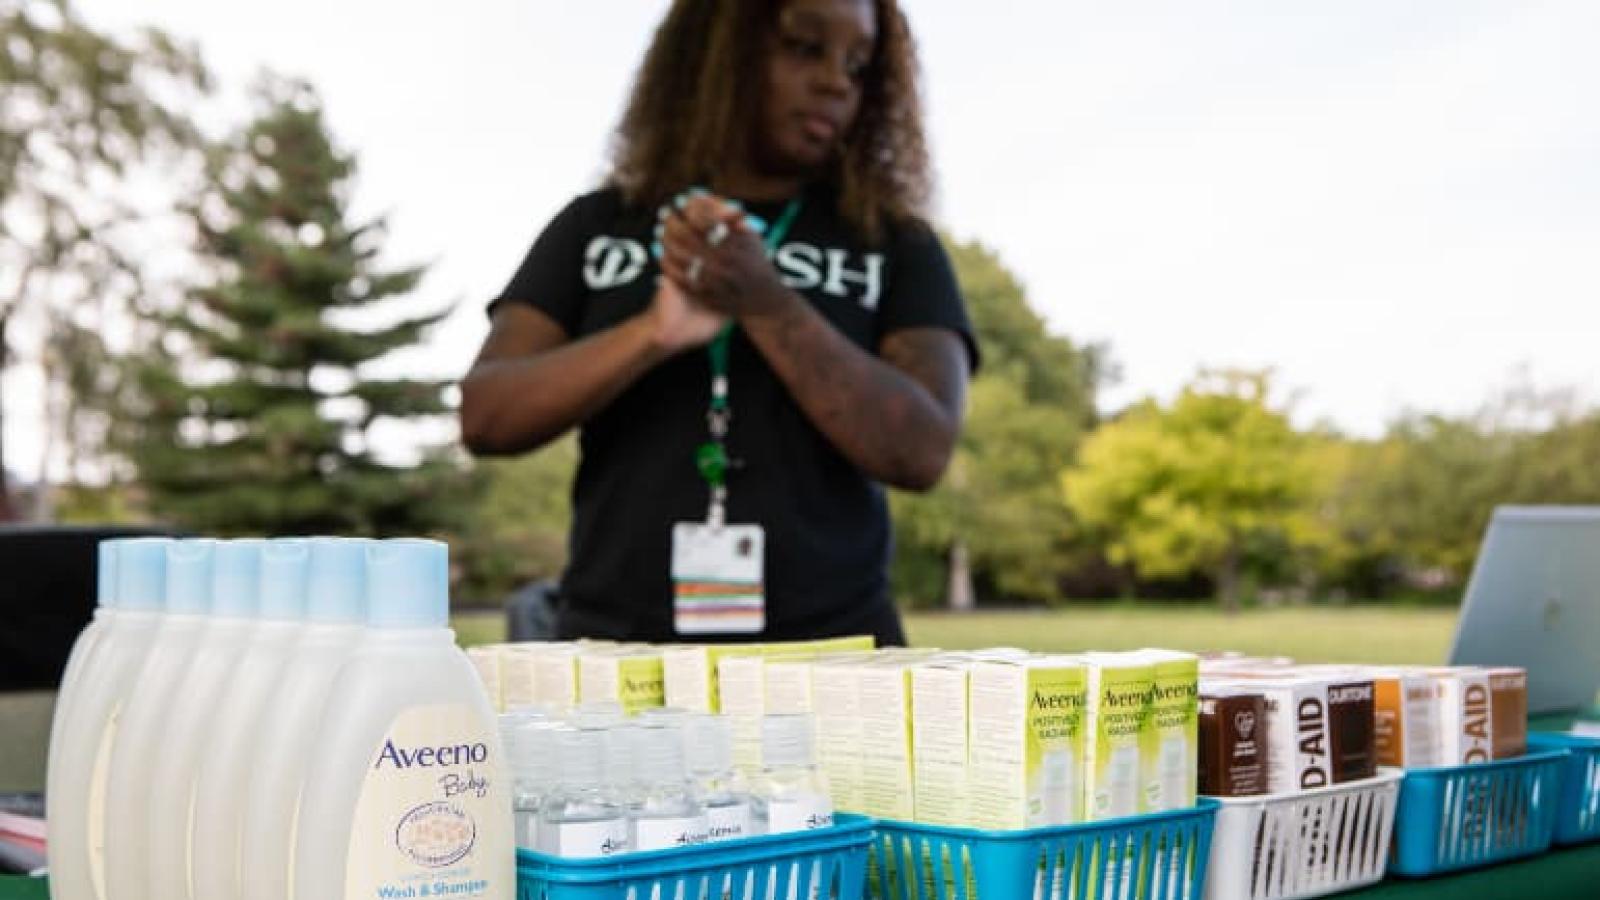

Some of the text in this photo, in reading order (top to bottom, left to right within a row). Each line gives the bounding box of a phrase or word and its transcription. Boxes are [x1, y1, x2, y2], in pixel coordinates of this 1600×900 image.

[1464, 683, 1489, 766] D-AID
[375, 737, 488, 770] Aveeno
[438, 770, 489, 798] Baby
[378, 883, 415, 898] Wash
